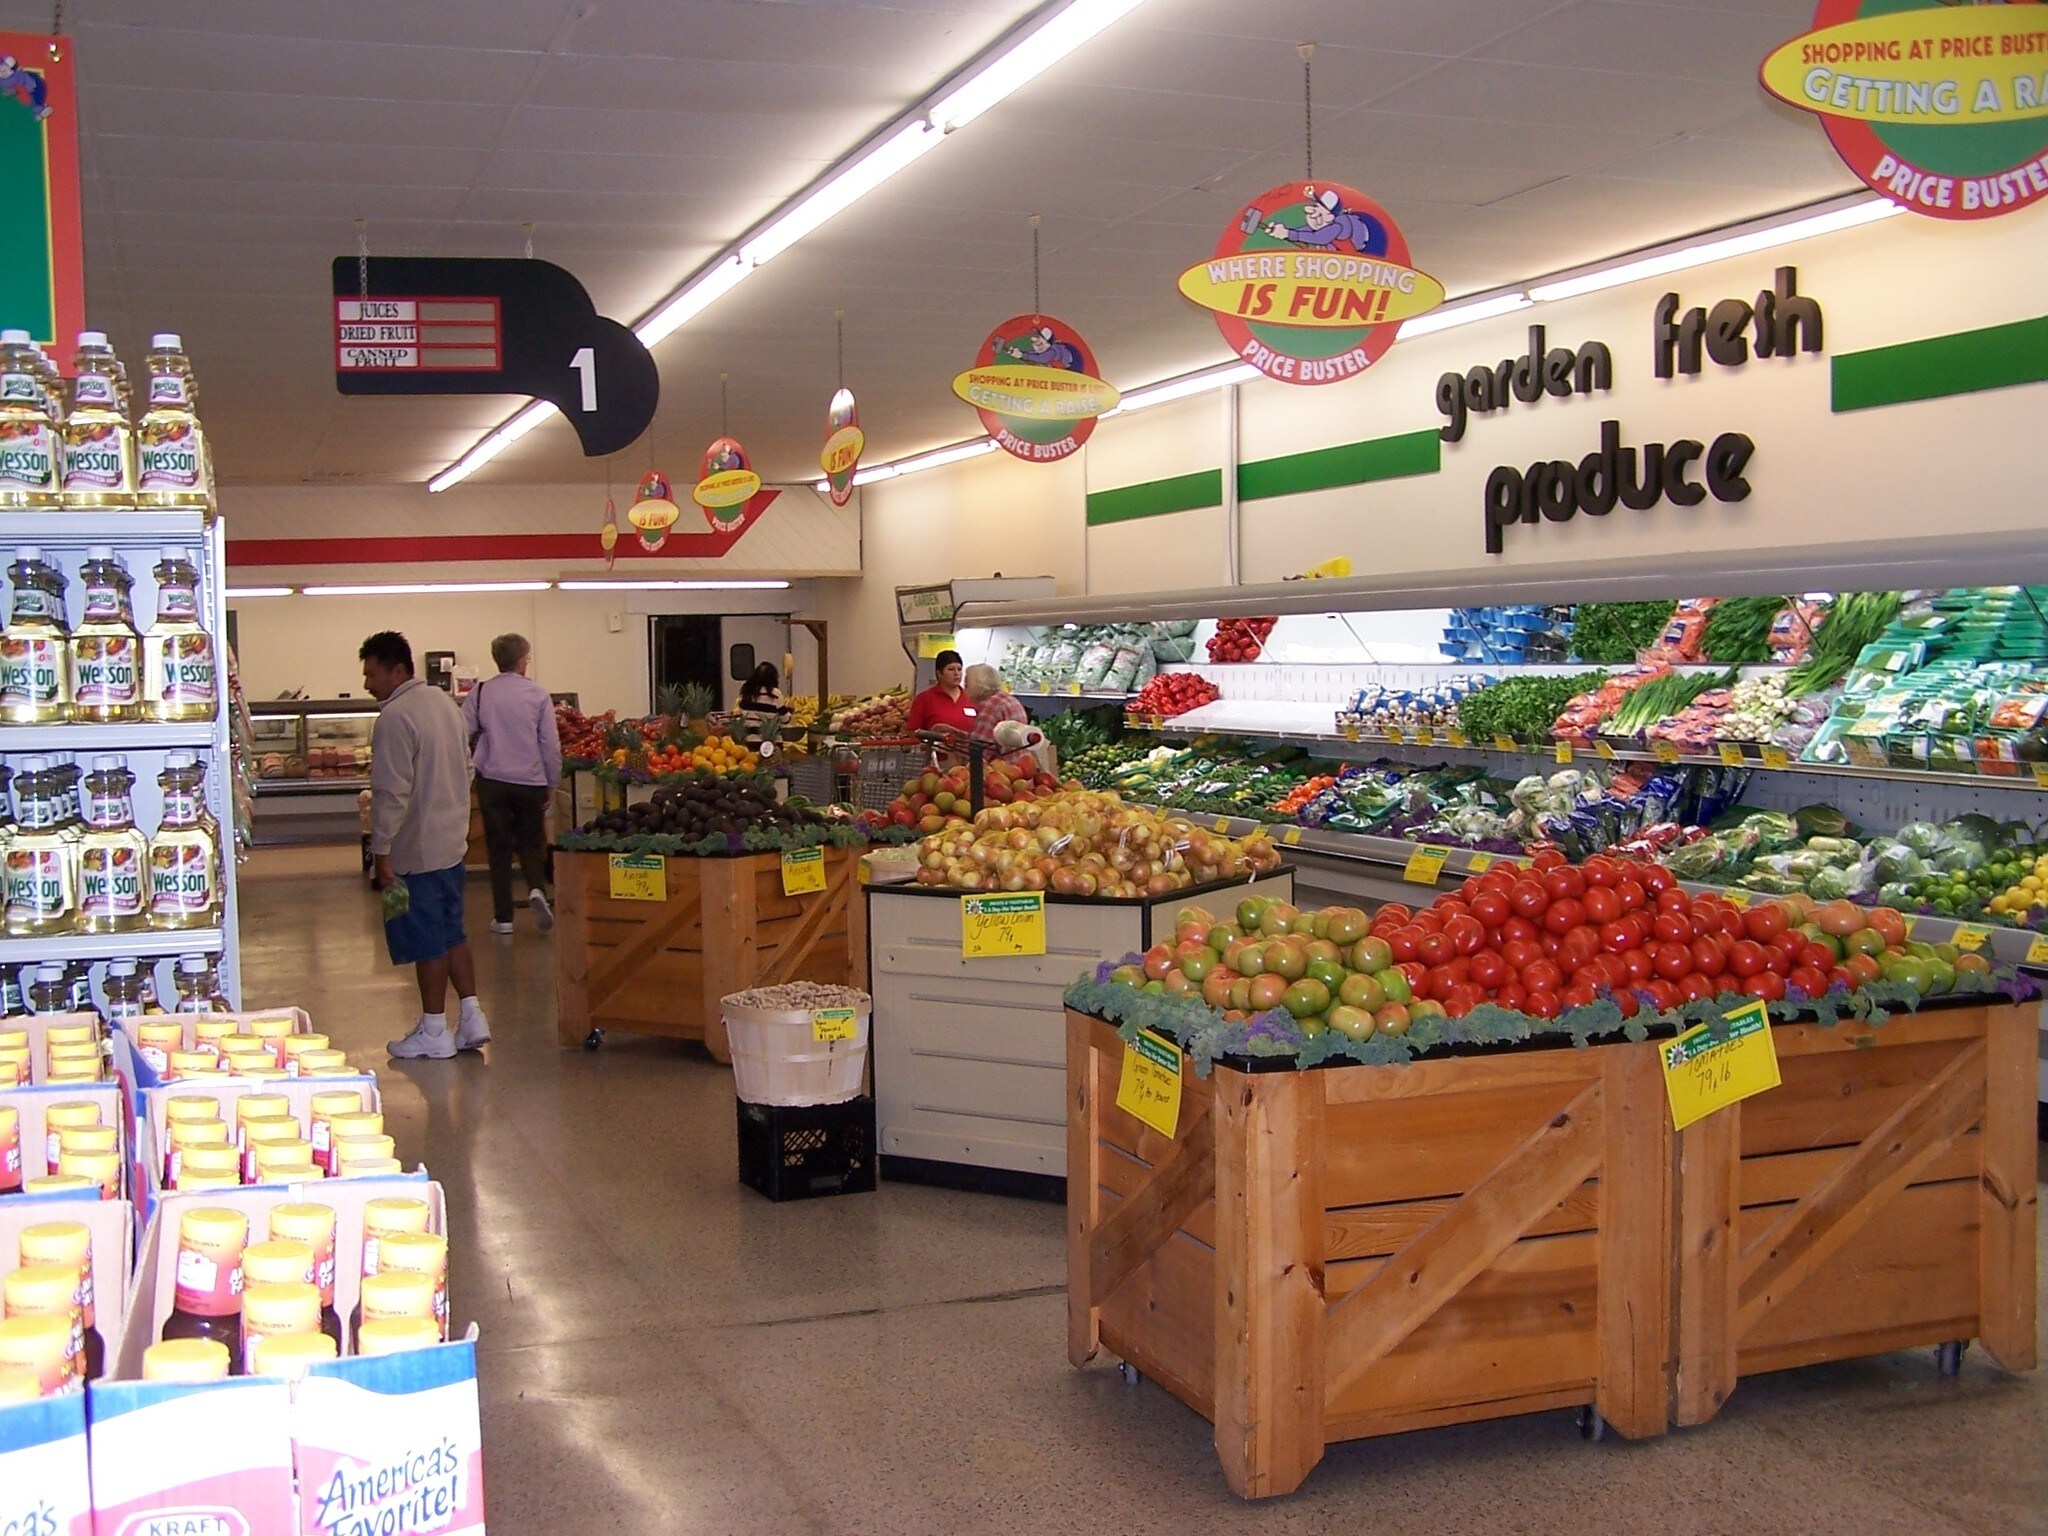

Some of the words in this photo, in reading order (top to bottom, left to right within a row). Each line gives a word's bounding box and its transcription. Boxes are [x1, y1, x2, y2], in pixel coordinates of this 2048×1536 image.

[1802, 40, 1901, 65] SHOPPING
[1908, 39, 1934, 60] AT
[1940, 36, 1993, 58] PRICE
[2000, 32, 2048, 55] BUST
[1803, 67, 1959, 115] GETTING
[1971, 79, 2001, 113] A
[1871, 154, 1953, 208] PRICE
[1962, 154, 2048, 210] BUSTE
[1207, 256, 1287, 284] WHERE
[1294, 256, 1417, 294] SHOPPING
[359, 303, 399, 321] JUICES
[1237, 283, 1277, 316] IS
[1288, 285, 1391, 322] FUN!
[340, 326, 376, 340] DRIED
[380, 326, 416, 340] FRUIT
[347, 349, 408, 358] CANNED
[1243, 339, 1295, 379] PRICE
[1300, 349, 1371, 381] BUSTER
[1435, 324, 1613, 442] garden
[1654, 266, 1823, 379] fresh
[569, 348, 597, 411] 1
[968, 374, 1012, 387] SHOPPING
[1013, 378, 1025, 387] AT
[1027, 379, 1048, 391] PRICE
[1051, 381, 1079, 392] BUSTER
[968, 386, 1033, 413] GETTING
[1040, 400, 1052, 414] A
[997, 428, 1030, 457] PRICE
[1034, 436, 1077, 459] BUSTER
[66, 451, 118, 471] Wesson
[142, 451, 195, 471] Wesson
[1484, 420, 1755, 554] produce
[1, 665, 55, 686] Weson
[78, 663, 133, 685] Weson
[85, 875, 138, 896] Weson
[1684, 1038, 1745, 1077] TOMATOES
[315, 1436, 458, 1528] America's
[326, 1475, 458, 1536] Favorite!
[151, 1517, 224, 1536] KRAFT
